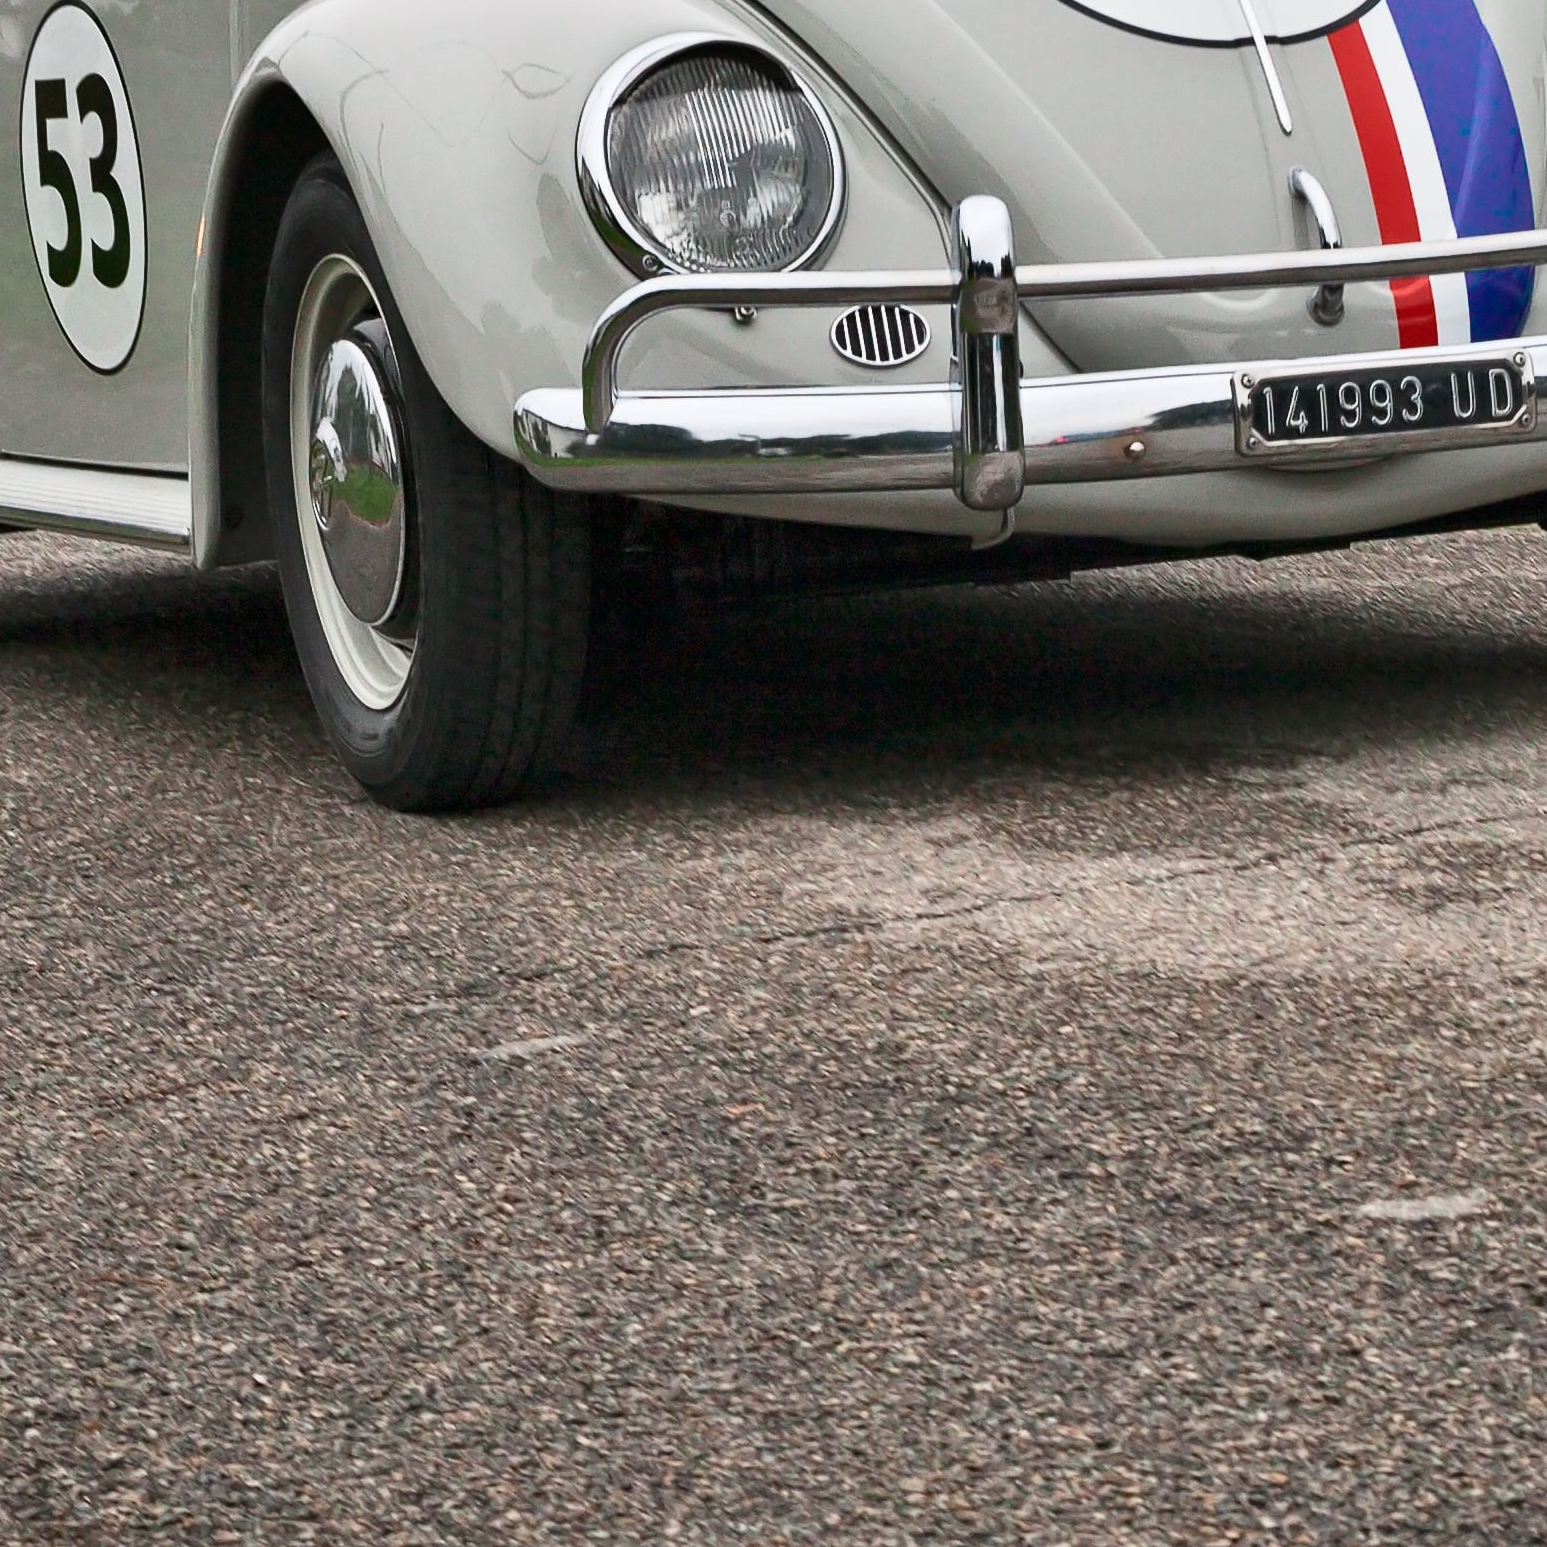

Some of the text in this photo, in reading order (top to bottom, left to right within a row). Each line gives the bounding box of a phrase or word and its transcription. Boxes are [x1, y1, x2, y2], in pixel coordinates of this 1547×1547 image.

[35, 73, 131, 288] 53
[1262, 368, 1514, 436] 141993 UD
